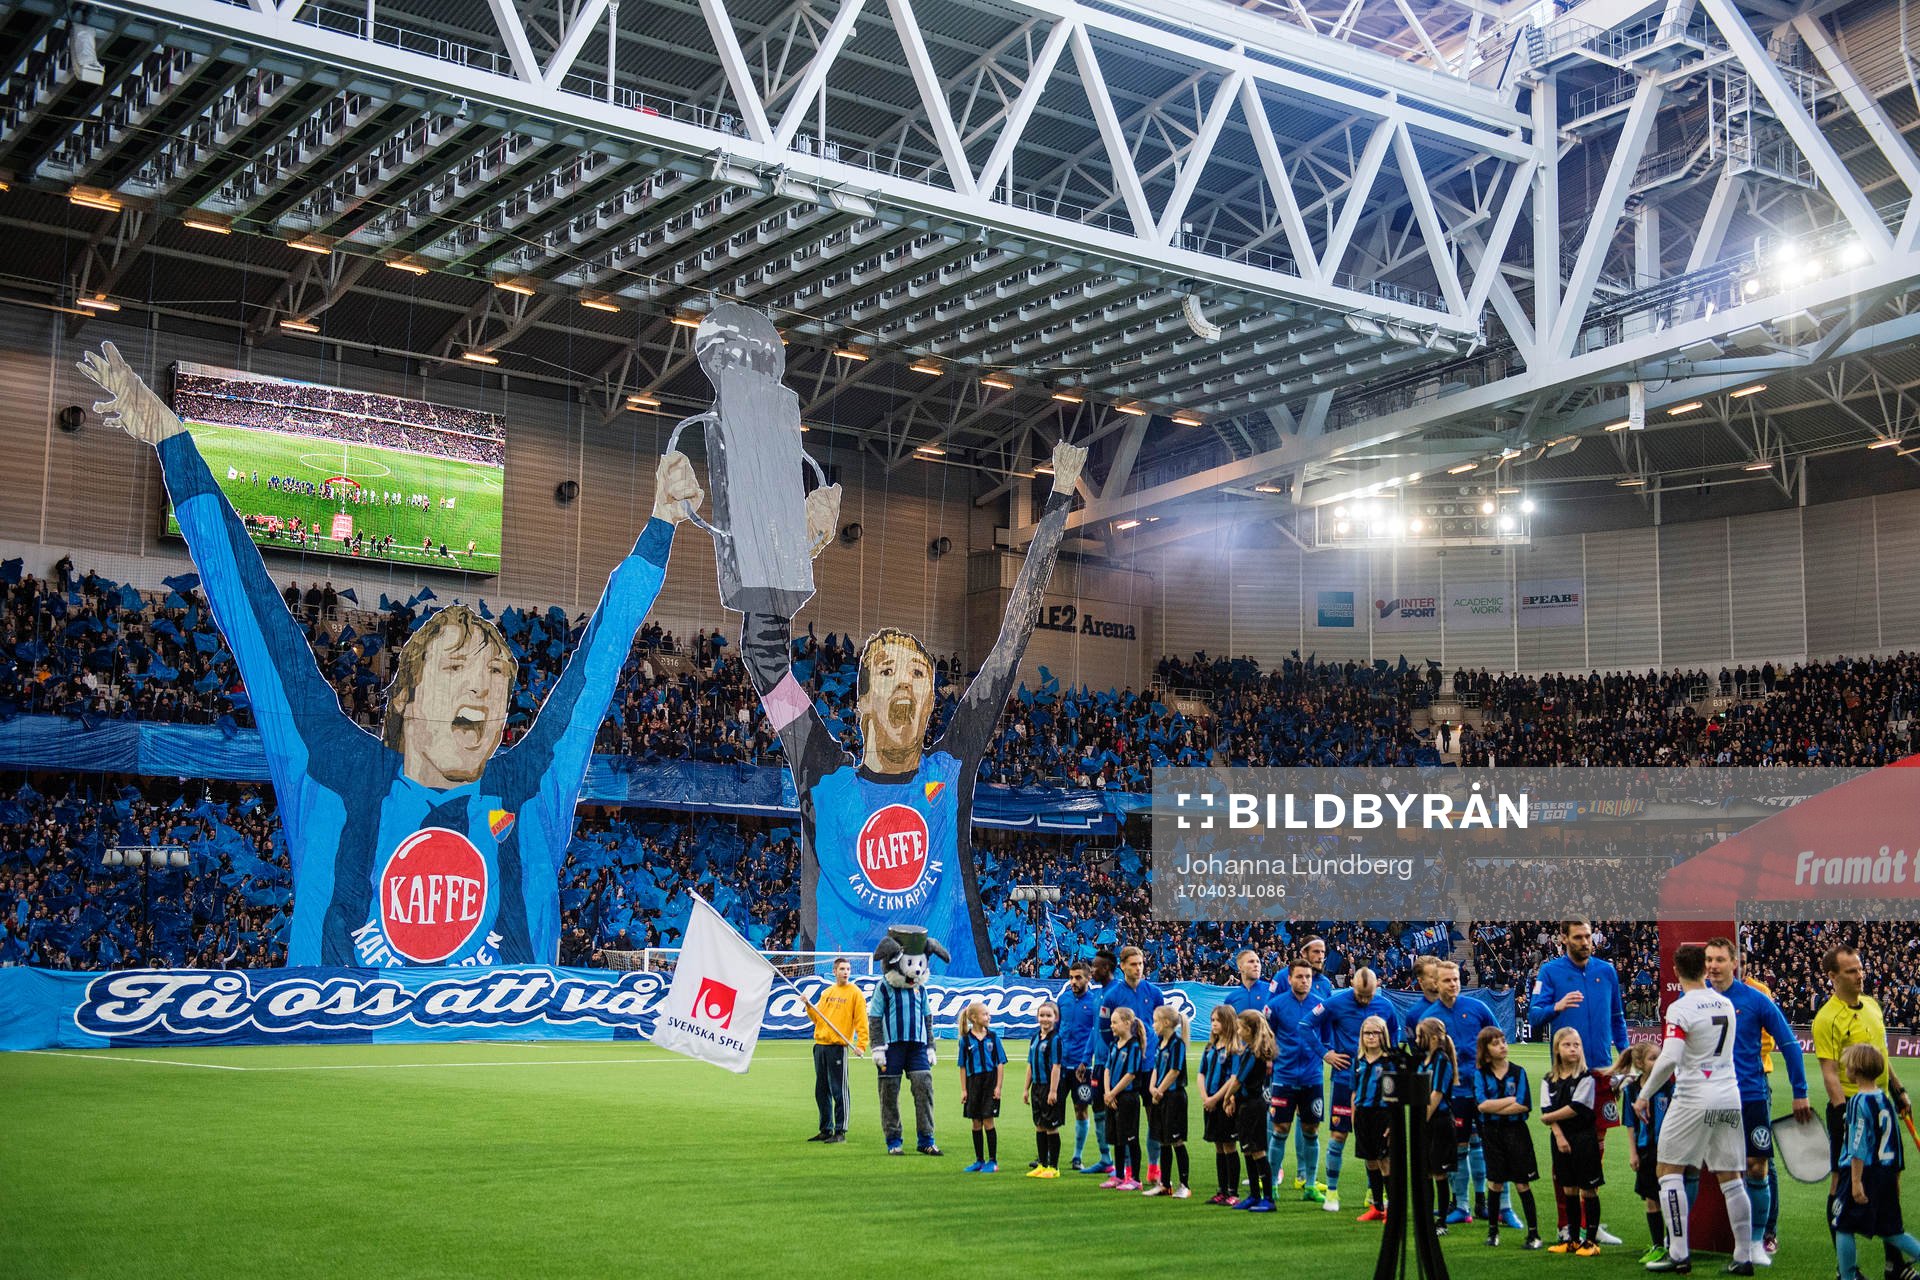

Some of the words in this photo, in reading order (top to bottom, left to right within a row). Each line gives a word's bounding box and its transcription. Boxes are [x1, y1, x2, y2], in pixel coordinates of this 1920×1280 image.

[1401, 598, 1435, 608] INTER
[1401, 608, 1436, 618] SPORT
[1453, 598, 1504, 606] ACADEMIC
[1529, 594, 1571, 604] PEAB
[1036, 605, 1077, 631] LE2
[1080, 614, 1136, 640] Arena
[865, 831, 924, 870] KAFFE
[1795, 845, 1908, 886] Framåt
[389, 875, 481, 924] KAFFE
[849, 860, 943, 910] KAFFEKNAPPEN
[95, 975, 250, 1023] Få
[267, 986, 413, 1017] oss
[424, 976, 551, 1015] att
[561, 979, 668, 1015] vå
[668, 1016, 715, 1042] SVENSKA
[718, 1036, 744, 1052] SPEL
[1711, 1016, 1729, 1056] 7
[1896, 1039, 1920, 1056] Pri
[1878, 1109, 1895, 1160] 2
